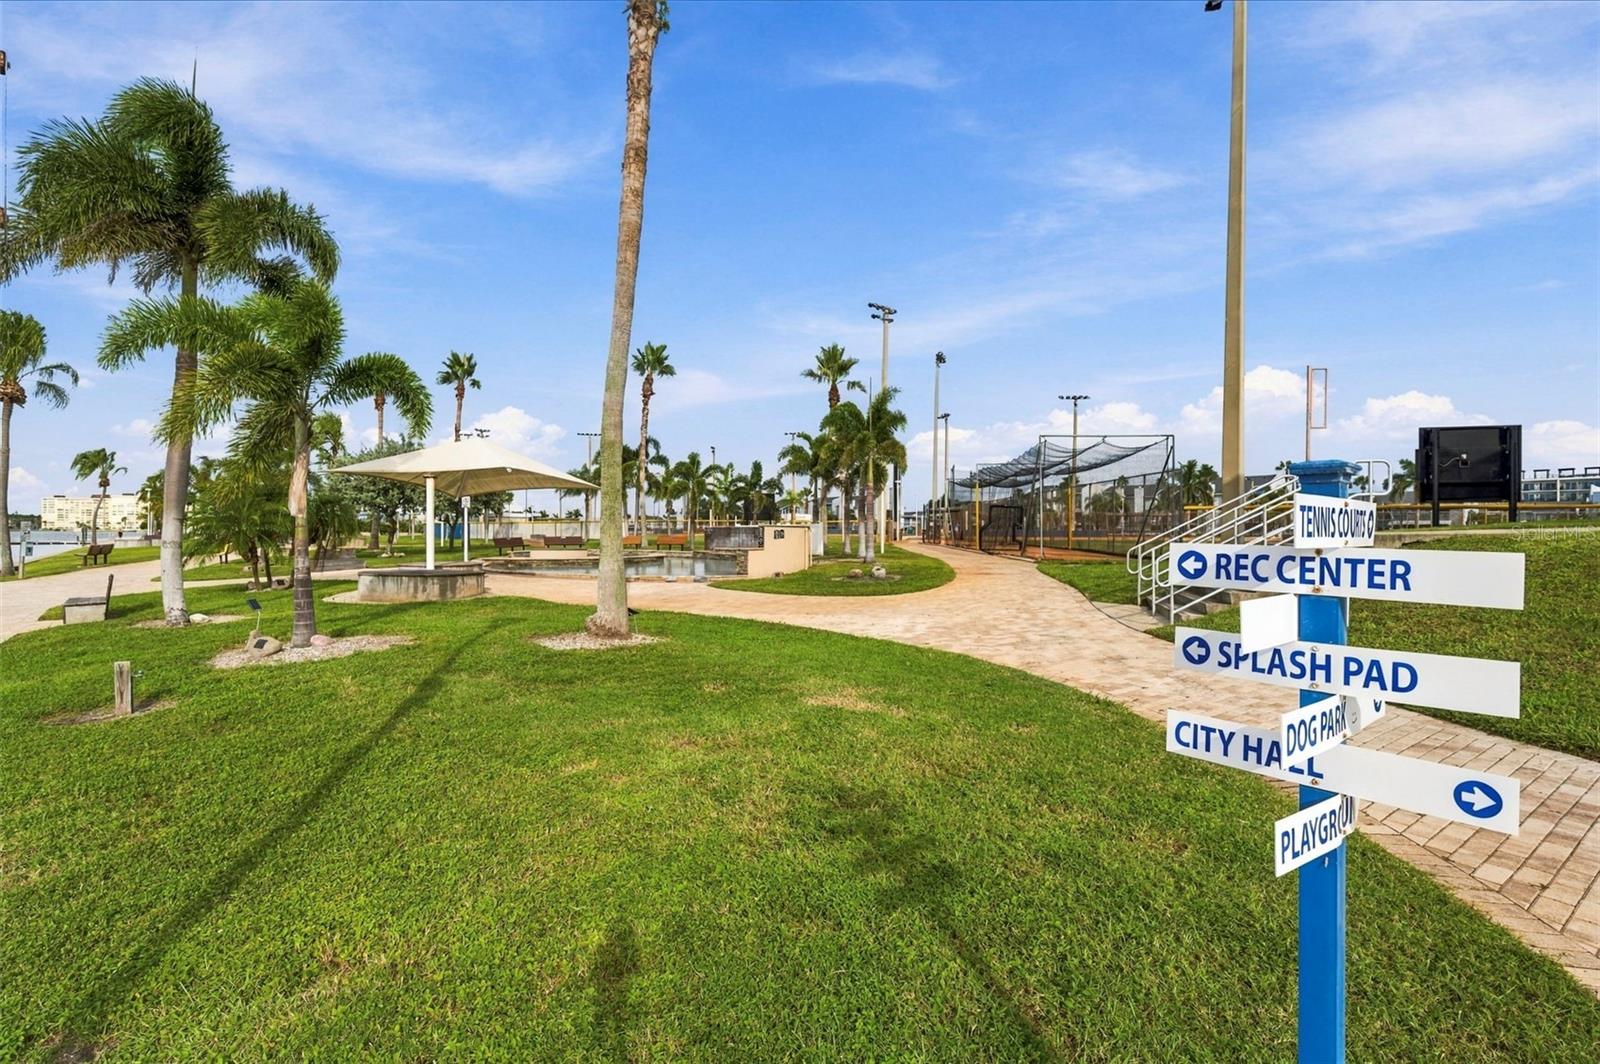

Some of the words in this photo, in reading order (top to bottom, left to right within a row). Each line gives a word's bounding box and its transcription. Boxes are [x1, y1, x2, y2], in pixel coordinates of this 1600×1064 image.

[1299, 505, 1337, 540] TENNIS
[1337, 507, 1367, 540] COURTS
[1215, 553, 1270, 583] REC
[1276, 554, 1412, 592] CENTER
[1217, 641, 1332, 684] SPLASH
[1343, 656, 1419, 694] PAD
[1174, 720, 1236, 758] CITY
[1287, 717, 1317, 757] DOG
[1320, 700, 1347, 742] PARK
